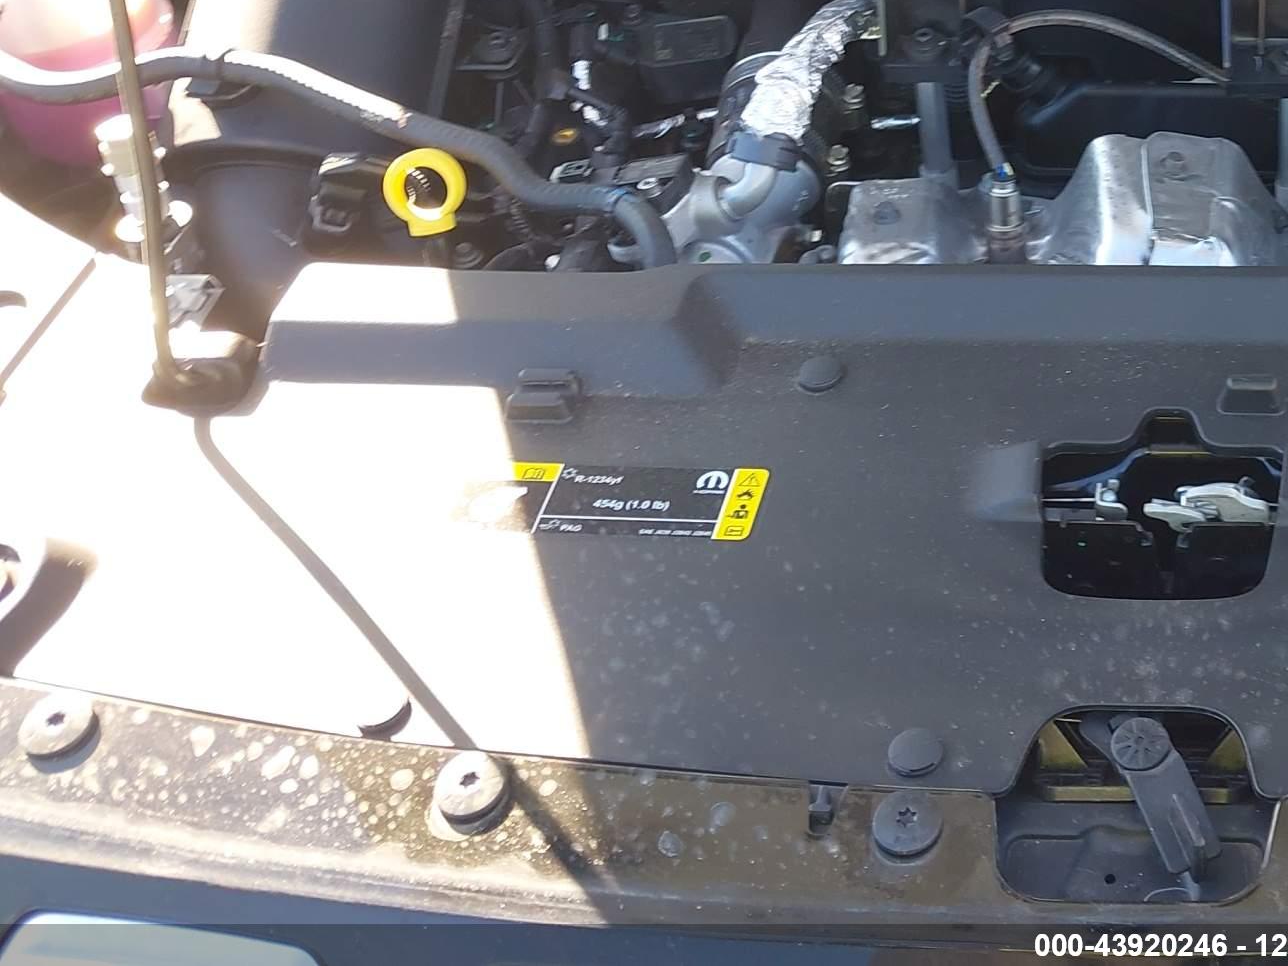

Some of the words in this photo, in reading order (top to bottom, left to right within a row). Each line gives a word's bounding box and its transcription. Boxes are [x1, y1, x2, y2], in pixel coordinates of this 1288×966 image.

[592, 499, 624, 511] 454g
[625, 500, 650, 511] (1.0
[651, 500, 671, 512] lb)
